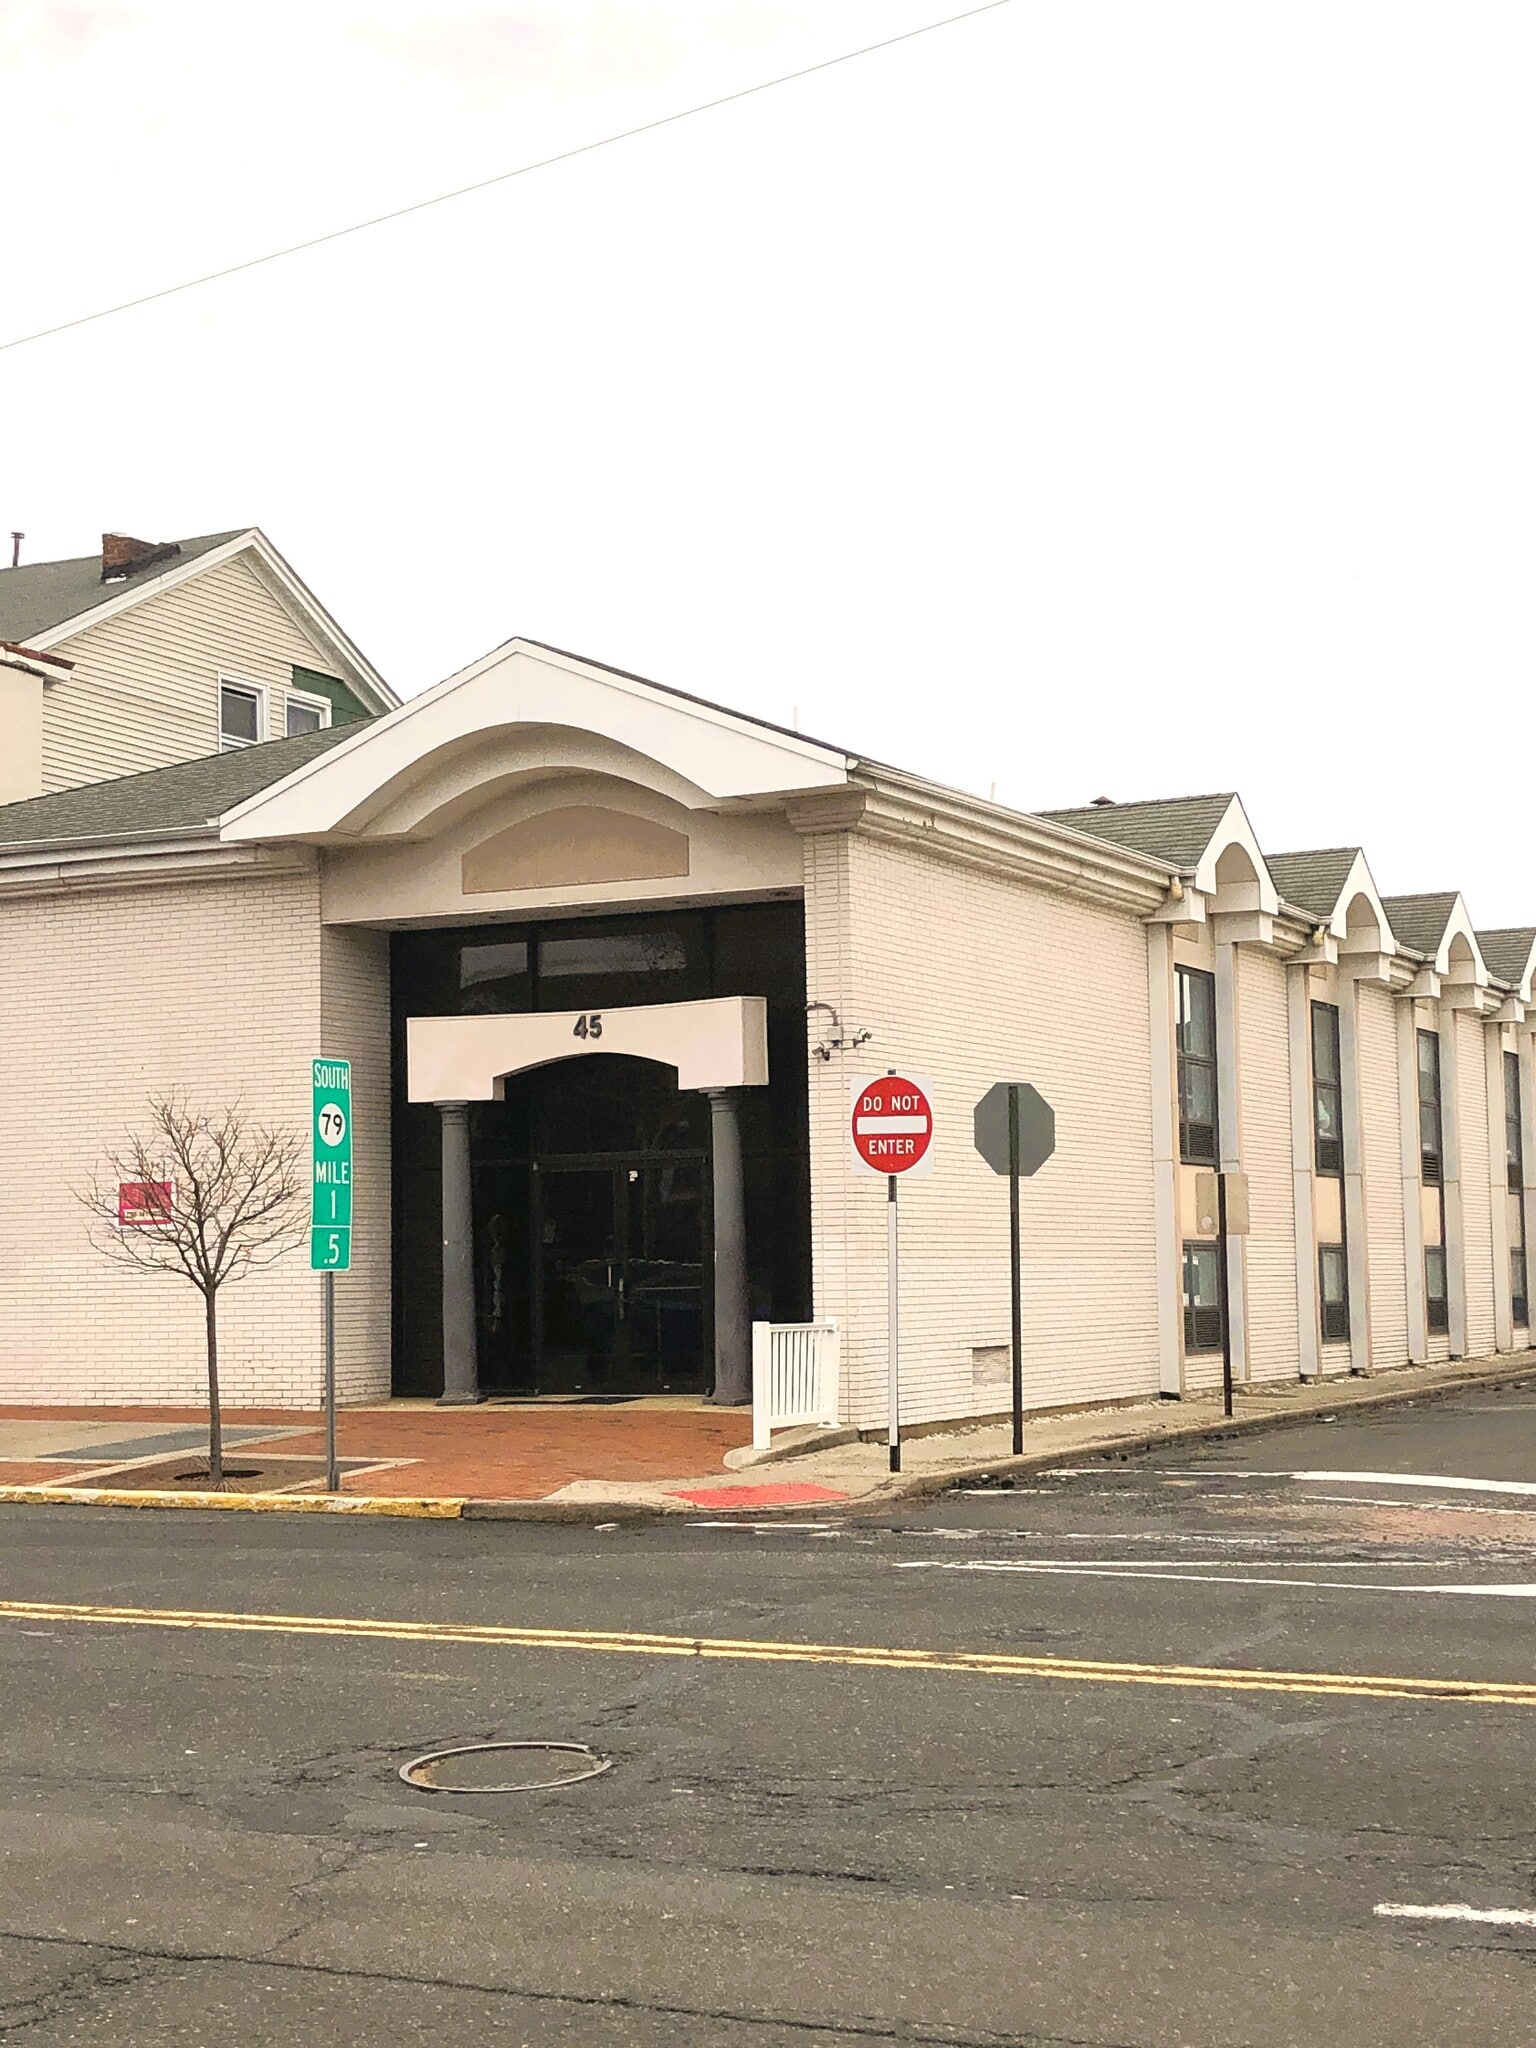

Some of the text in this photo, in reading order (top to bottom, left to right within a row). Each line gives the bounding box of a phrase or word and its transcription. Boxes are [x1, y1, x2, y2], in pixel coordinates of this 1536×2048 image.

[573, 1014, 603, 1040] 45
[314, 1062, 349, 1090] SOUTH
[863, 1095, 920, 1111] DO NOT
[321, 1112, 343, 1136] 79
[868, 1139, 915, 1155] ENTER
[315, 1160, 350, 1185] MILE
[330, 1189, 336, 1219] 1
